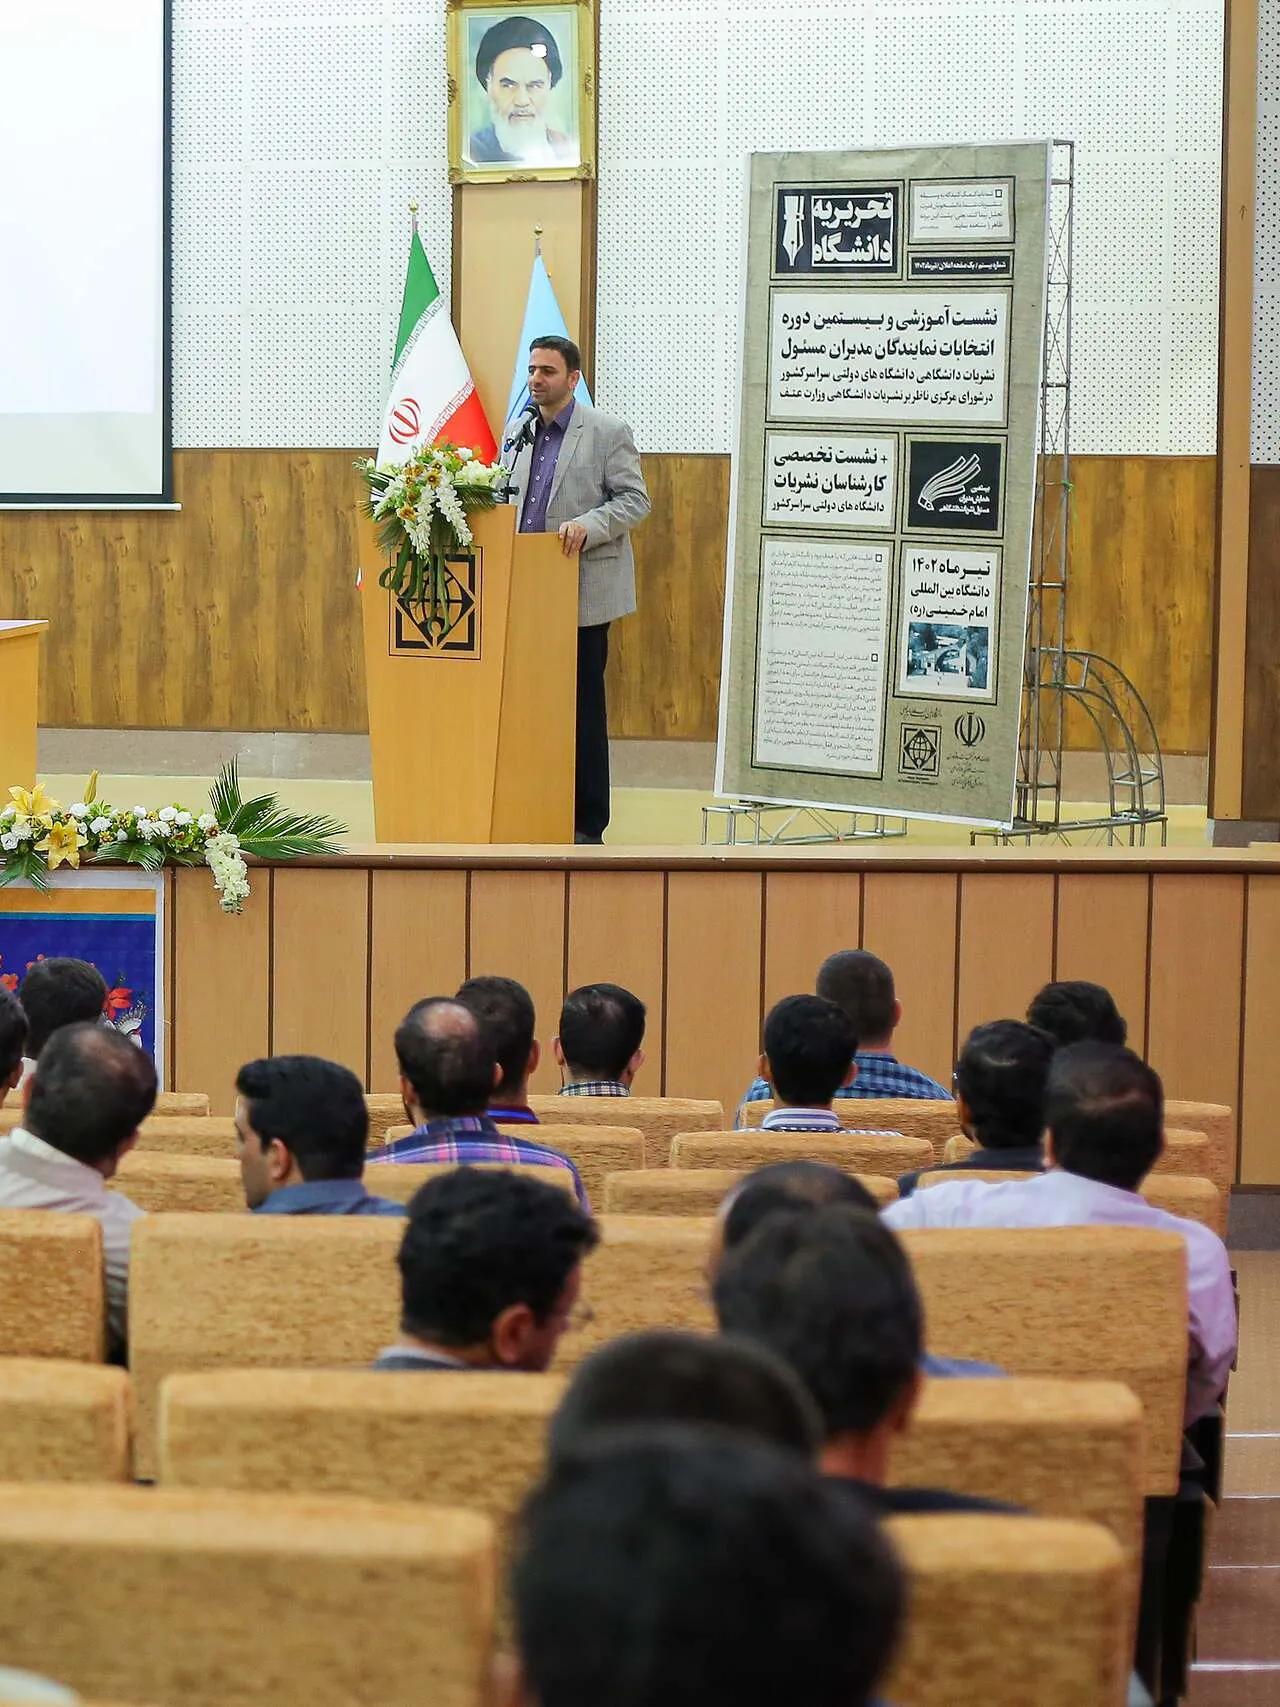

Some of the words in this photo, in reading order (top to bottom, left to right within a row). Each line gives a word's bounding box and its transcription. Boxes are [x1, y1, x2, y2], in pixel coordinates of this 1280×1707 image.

[814, 192, 893, 229] تحریریه
[814, 232, 892, 262] دانشگاه
[782, 311, 811, 330] دوره
[813, 311, 884, 331] بیستمین
[886, 315, 894, 331] و
[896, 304, 951, 331] آموزشی
[952, 308, 998, 326] نشست
[781, 337, 827, 360] مسئول
[829, 338, 872, 361] مدیران
[874, 337, 937, 361] نمایندگان
[940, 338, 995, 361] انتخابات
[833, 367, 859, 382] دولتی
[861, 367, 877, 382] های
[879, 366, 915, 381] دانشگاه
[916, 367, 961, 383] دانشگاهی
[963, 368, 995, 385] نشریات
[780, 387, 802, 398] عتف
[804, 387, 825, 402] وزارت
[827, 388, 871, 402] دانشگاهی
[931, 390, 957, 405] مرکزی
[774, 445, 832, 467] تخصصی
[835, 447, 878, 464] نشست
[774, 471, 819, 494] نشریات
[821, 472, 887, 497] کارشناسان
[812, 499, 836, 513] دولتی
[837, 500, 853, 513] های
[854, 500, 885, 512] دانشگاه
[913, 557, 937, 573] ۱۴۰۲
[939, 558, 960, 574] ماه
[960, 560, 991, 579] تیر
[910, 582, 939, 597] المللی
[940, 586, 955, 599] بین
[955, 584, 990, 597] دانشگاه
[968, 605, 988, 621] امام
